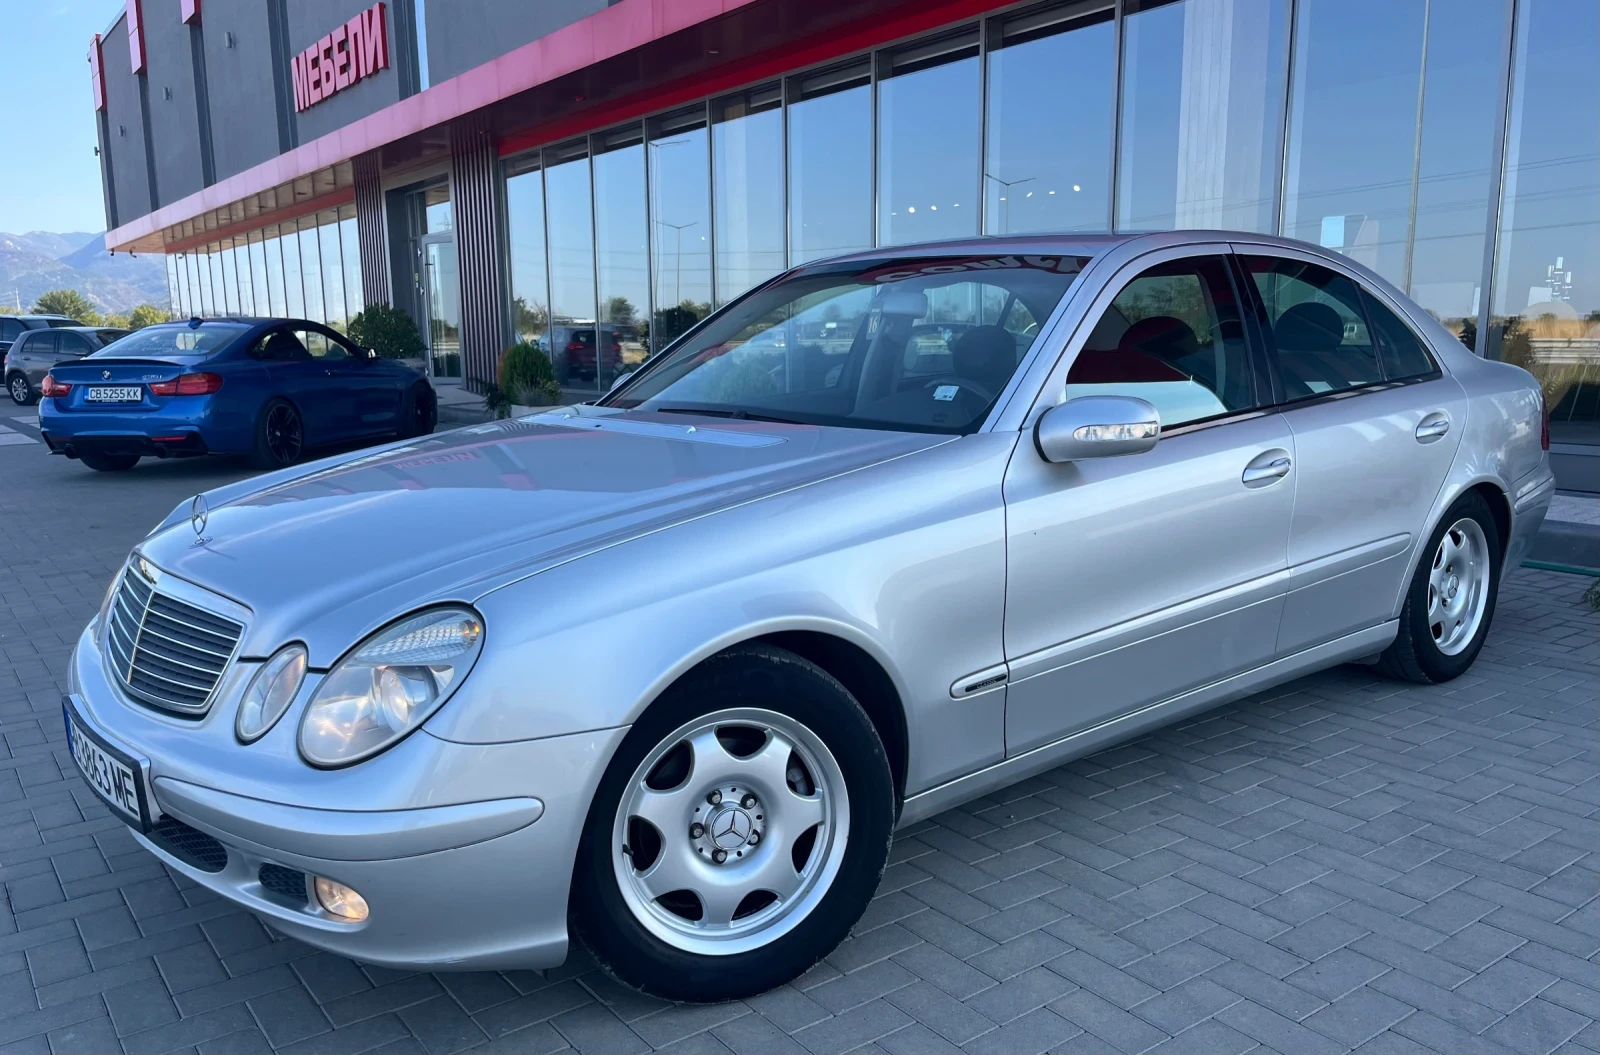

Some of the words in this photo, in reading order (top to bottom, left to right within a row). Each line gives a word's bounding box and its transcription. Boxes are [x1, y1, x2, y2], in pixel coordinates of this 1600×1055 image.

[290, 2, 389, 113] МЕБЕЛИ
[90, 388, 102, 399] CB
[103, 388, 126, 399] 5255
[126, 388, 139, 399] KK
[110, 761, 139, 817] ME
